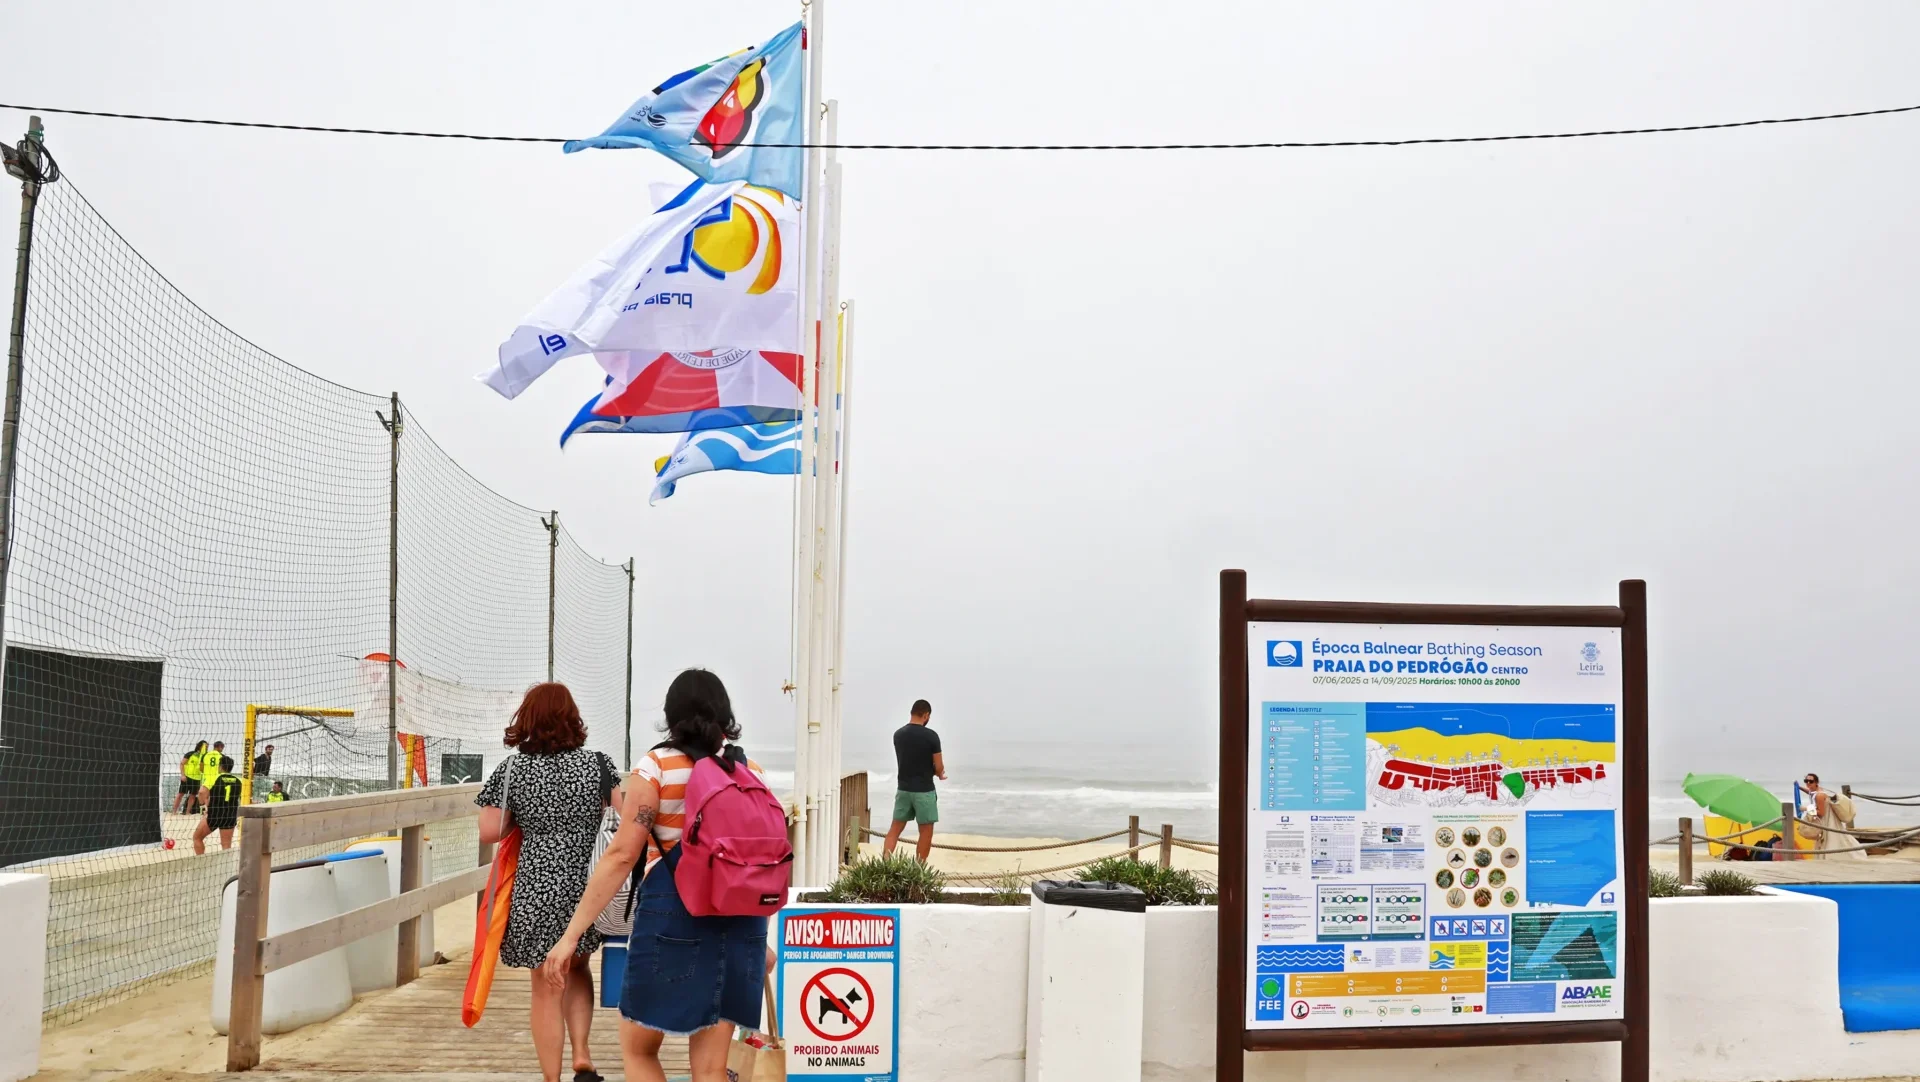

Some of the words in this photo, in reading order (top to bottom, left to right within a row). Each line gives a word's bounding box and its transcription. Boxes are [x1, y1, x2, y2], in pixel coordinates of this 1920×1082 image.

[1312, 637, 1360, 656] Época
[1363, 641, 1423, 655] Balnear
[1427, 642, 1485, 658] Bathing
[1489, 643, 1543, 656] Season
[1313, 659, 1366, 673] PRAIA
[1369, 660, 1394, 674] DO
[1397, 657, 1488, 675] PEDRÓGÃO
[1491, 666, 1529, 675] CENTRO
[1580, 662, 1604, 671] Leiria
[1312, 676, 1361, 685] 07/06/2025
[1371, 677, 1418, 686] 14/09/2025
[1419, 677, 1456, 686] Horários:
[1458, 678, 1482, 686] 10h00
[1484, 678, 1494, 686] às
[1495, 678, 1521, 686] 20h00
[210, 756, 216, 767] 8
[224, 785, 231, 801] 1
[784, 919, 824, 945] AVISO
[831, 919, 894, 945] WARNING
[783, 951, 801, 960] PERIGO
[802, 951, 809, 960] DE
[810, 951, 842, 960] AFOGAMENTO
[846, 951, 866, 960] DANGER
[867, 951, 894, 960] DROWNING
[1562, 985, 1612, 999] ABAAE
[1259, 1000, 1281, 1010] FEE
[794, 1045, 838, 1055] PROIBIDO
[840, 1045, 879, 1055] ANIMAIS
[807, 1057, 823, 1067] NO
[825, 1057, 866, 1067] ANIMALS
